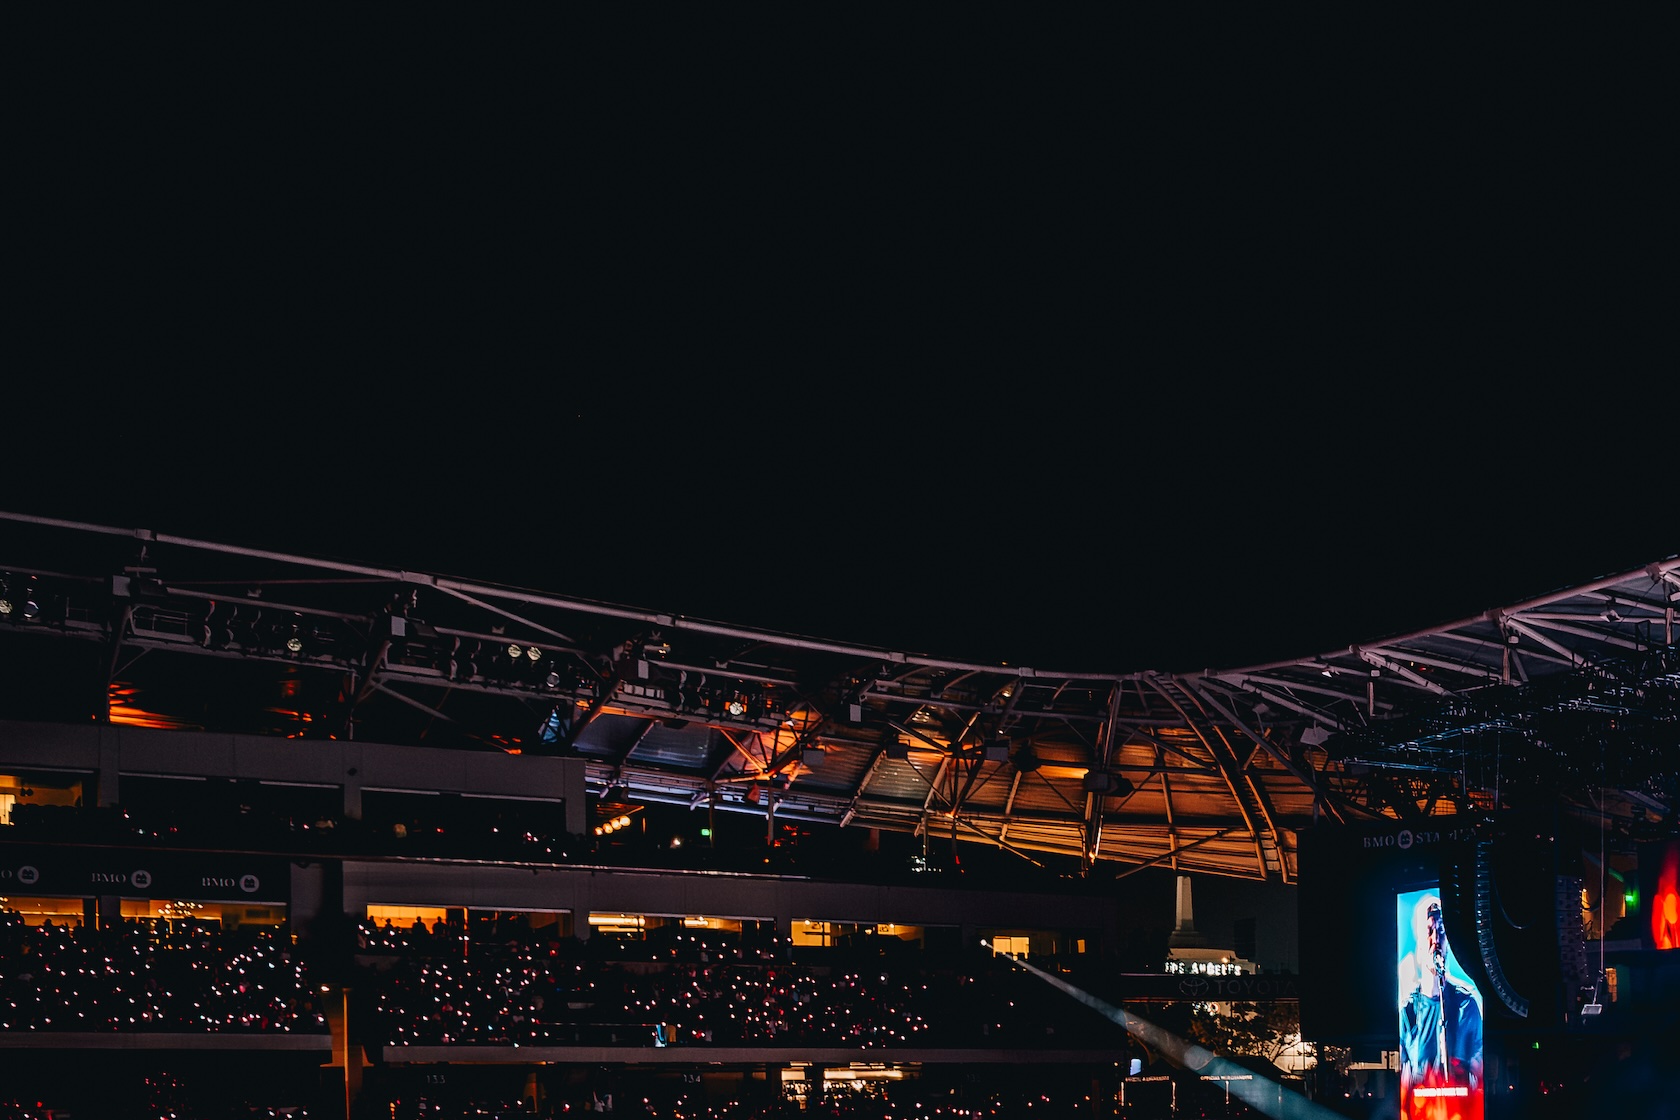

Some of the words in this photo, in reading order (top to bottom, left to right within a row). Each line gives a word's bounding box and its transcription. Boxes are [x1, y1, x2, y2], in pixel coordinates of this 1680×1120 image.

[1363, 835, 1395, 849] BMO
[91, 872, 127, 884] BMO
[201, 876, 236, 888] BMO
[1213, 979, 1298, 995] TOYOTA
[682, 1073, 701, 1084] 134
